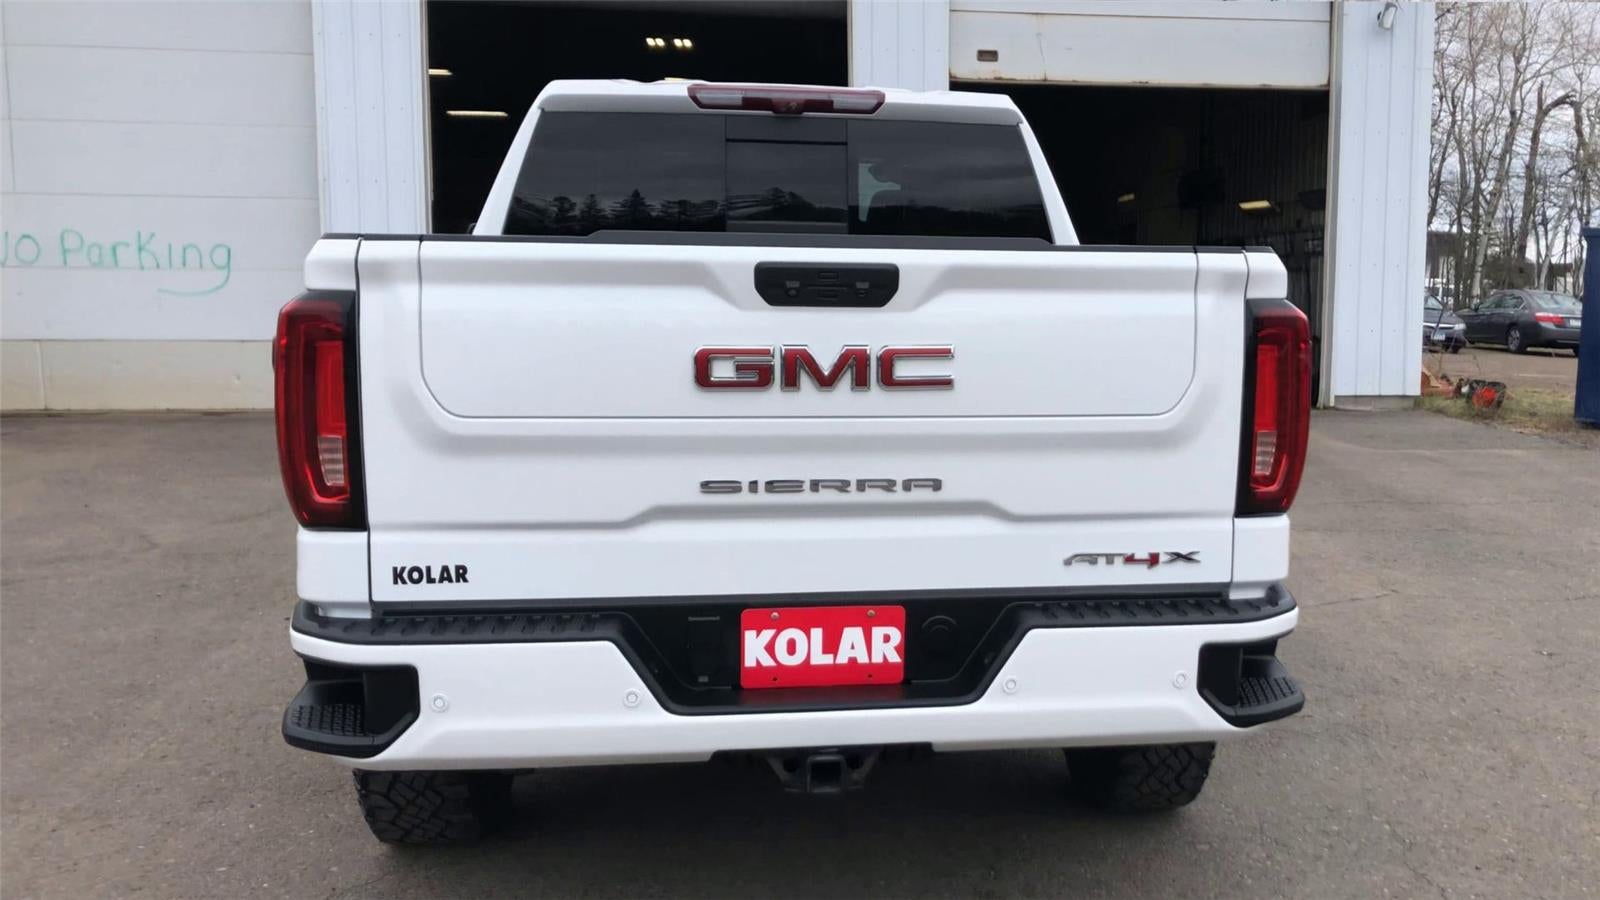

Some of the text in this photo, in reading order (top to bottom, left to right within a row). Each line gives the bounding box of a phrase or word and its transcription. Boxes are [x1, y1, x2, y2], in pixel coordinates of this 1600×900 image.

[694, 344, 955, 392] GMC
[699, 478, 942, 494] SIERRA
[392, 564, 469, 585] KOLAR
[744, 626, 902, 668] KOLAR
